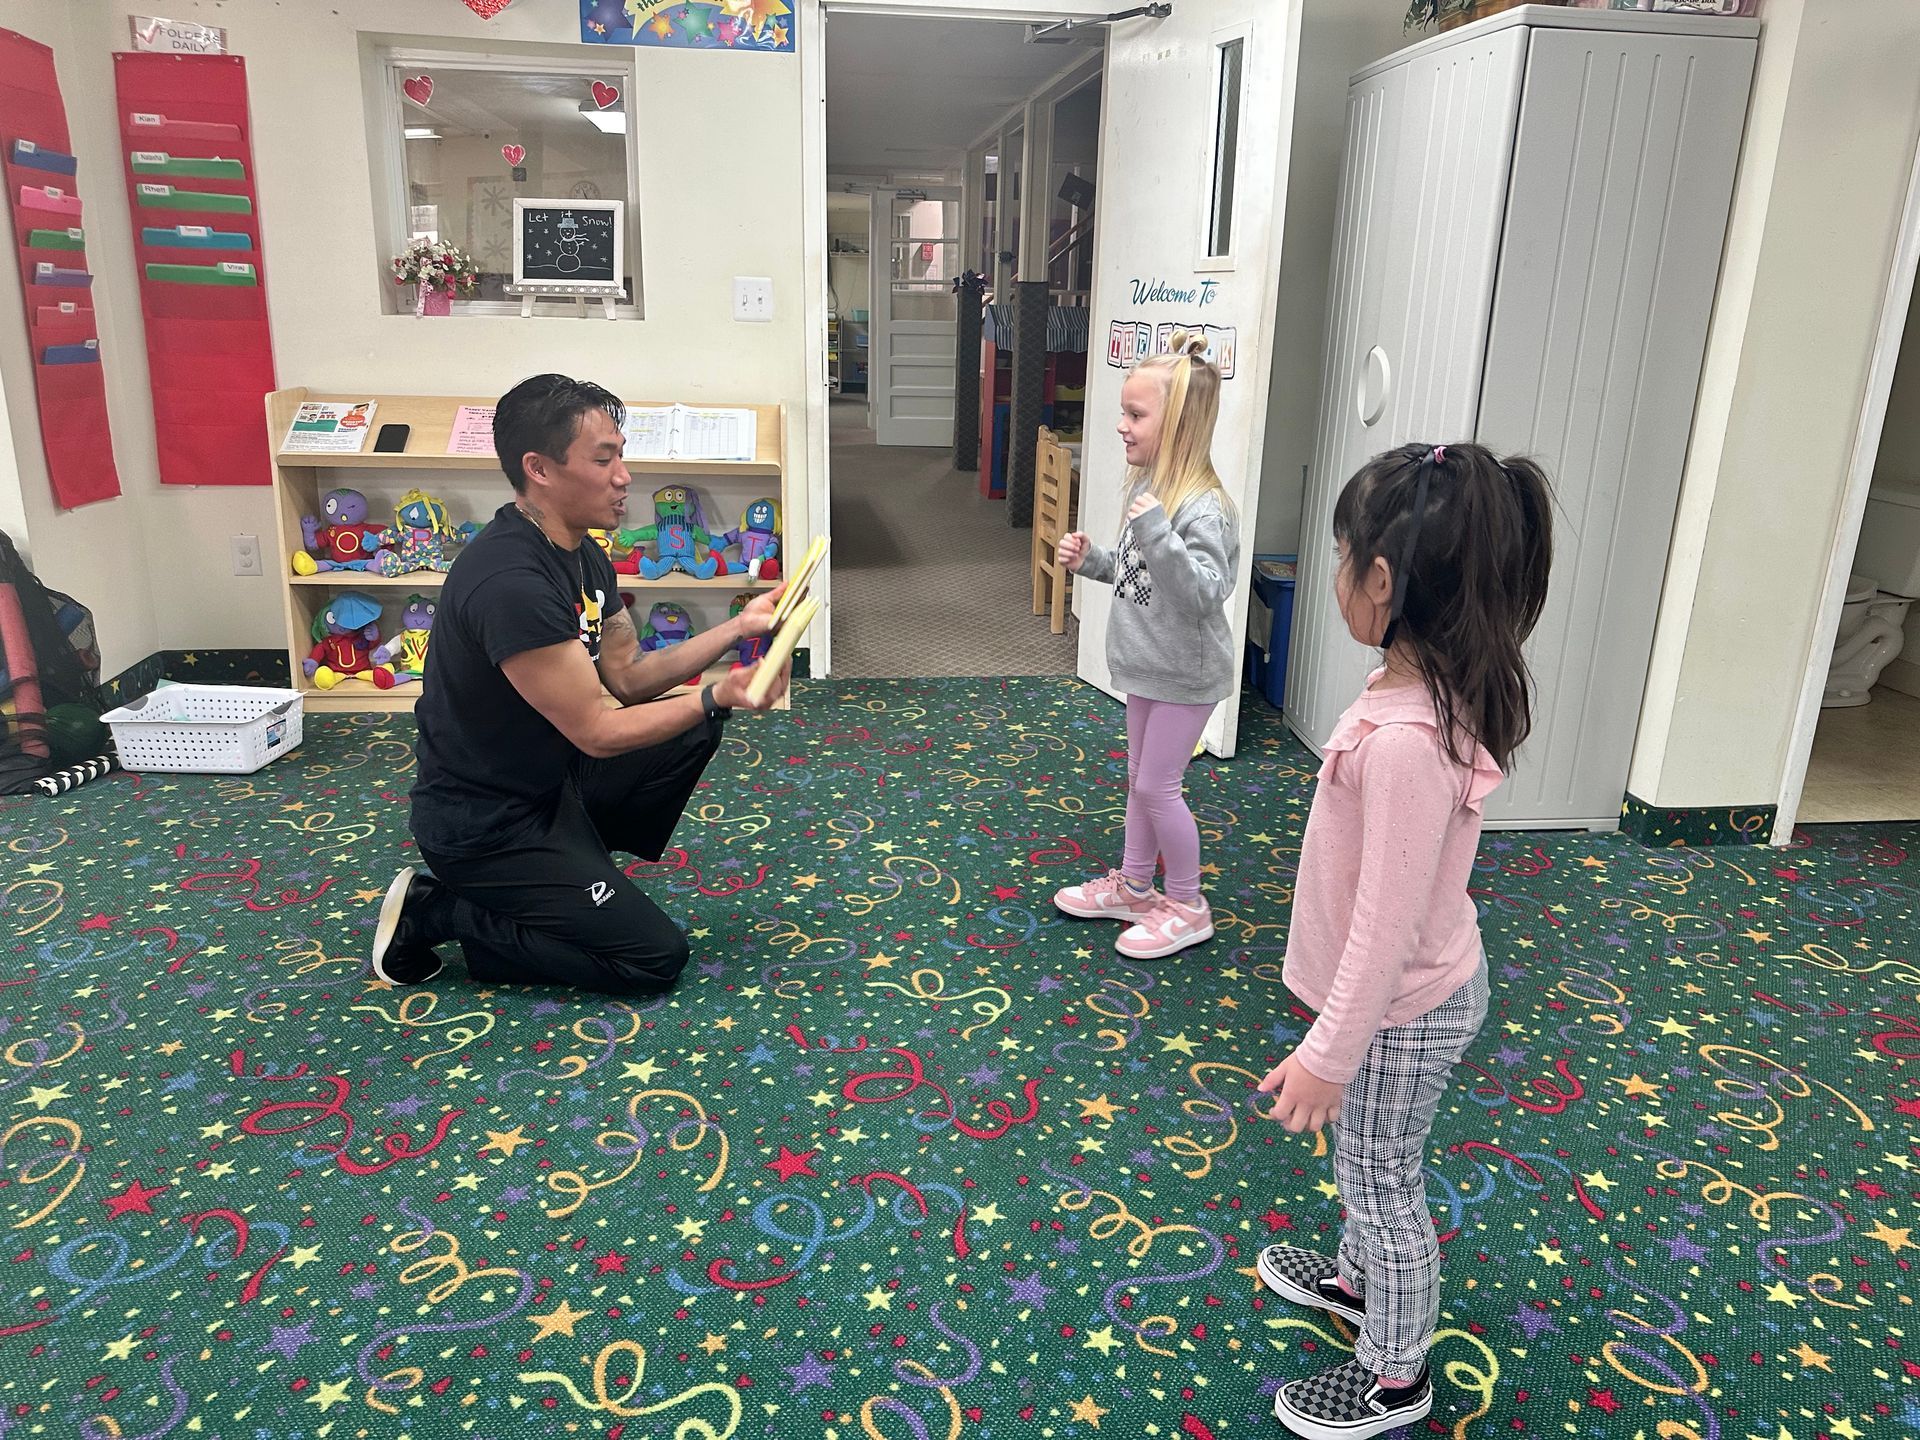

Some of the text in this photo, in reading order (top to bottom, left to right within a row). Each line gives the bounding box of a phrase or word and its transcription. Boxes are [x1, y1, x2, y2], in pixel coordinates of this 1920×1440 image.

[172, 40, 208, 53] DAILY
[144, 184, 166, 194] Rhett
[528, 210, 613, 229] Let it Snow!
[1129, 277, 1221, 308] Welcome To
[336, 531, 359, 554] O
[412, 528, 432, 552] P
[669, 525, 686, 550] S
[747, 535, 764, 563] T
[336, 643, 357, 668] U
[411, 637, 430, 661] V
[745, 637, 765, 659] Z
